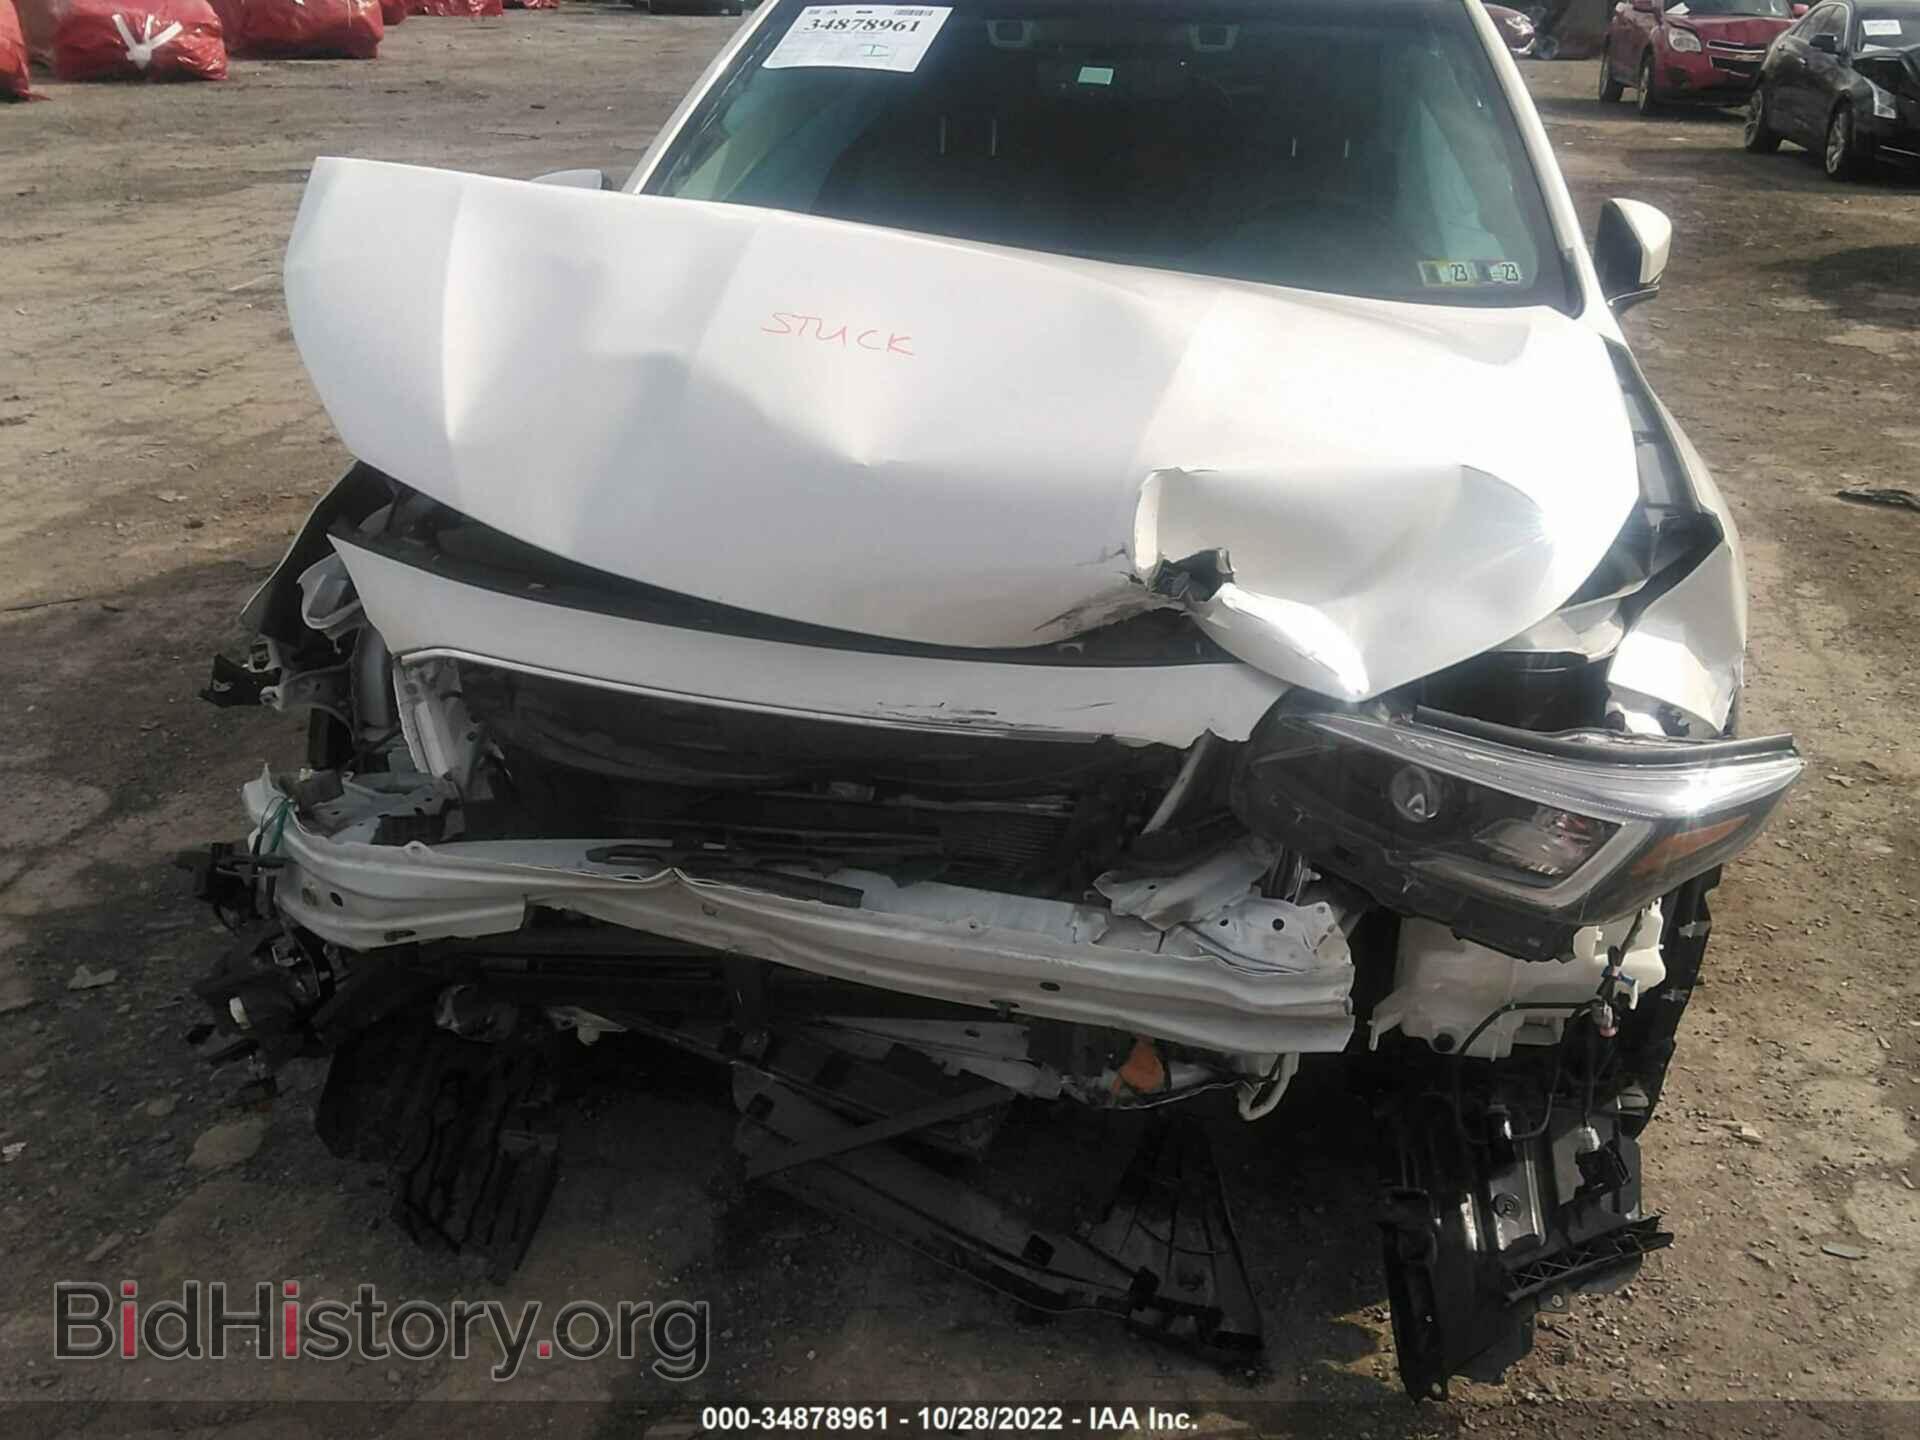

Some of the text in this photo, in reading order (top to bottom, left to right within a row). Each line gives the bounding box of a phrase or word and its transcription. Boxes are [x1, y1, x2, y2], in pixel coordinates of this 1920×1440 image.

[803, 18, 921, 33] 34878961
[1450, 263, 1468, 282] 23
[1502, 263, 1519, 282] 23
[760, 312, 916, 357] STUCK
